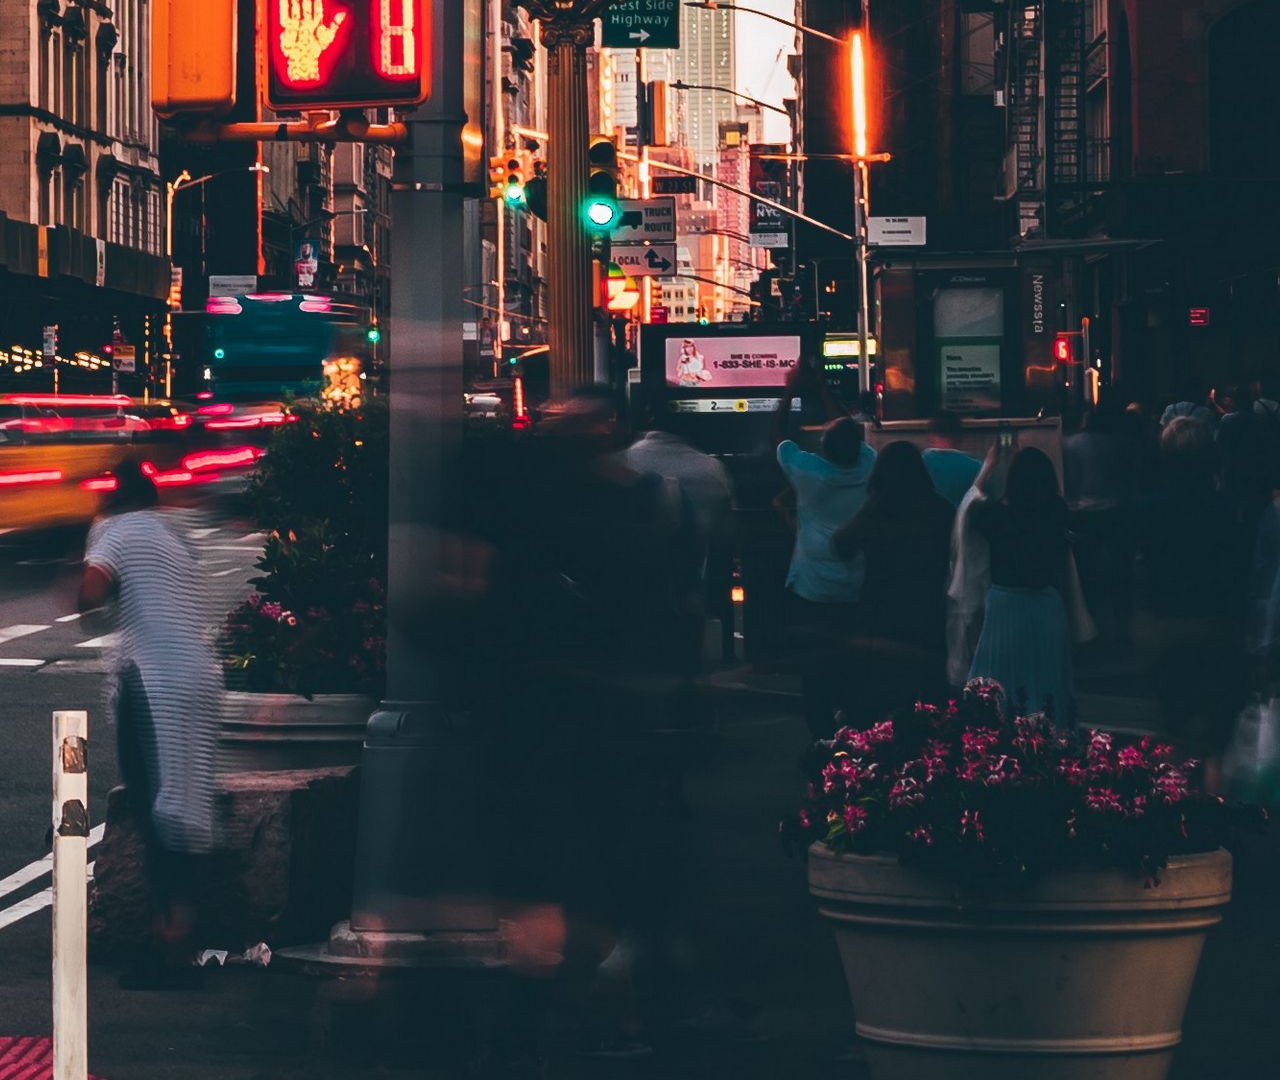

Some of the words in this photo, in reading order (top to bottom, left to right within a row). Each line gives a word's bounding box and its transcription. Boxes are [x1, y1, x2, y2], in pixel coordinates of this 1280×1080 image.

[646, 0, 674, 11] Side
[611, 14, 670, 28] Highway
[644, 207, 672, 217] TRUCK
[644, 222, 672, 232] ROUTE
[613, 255, 640, 266] LOCAL
